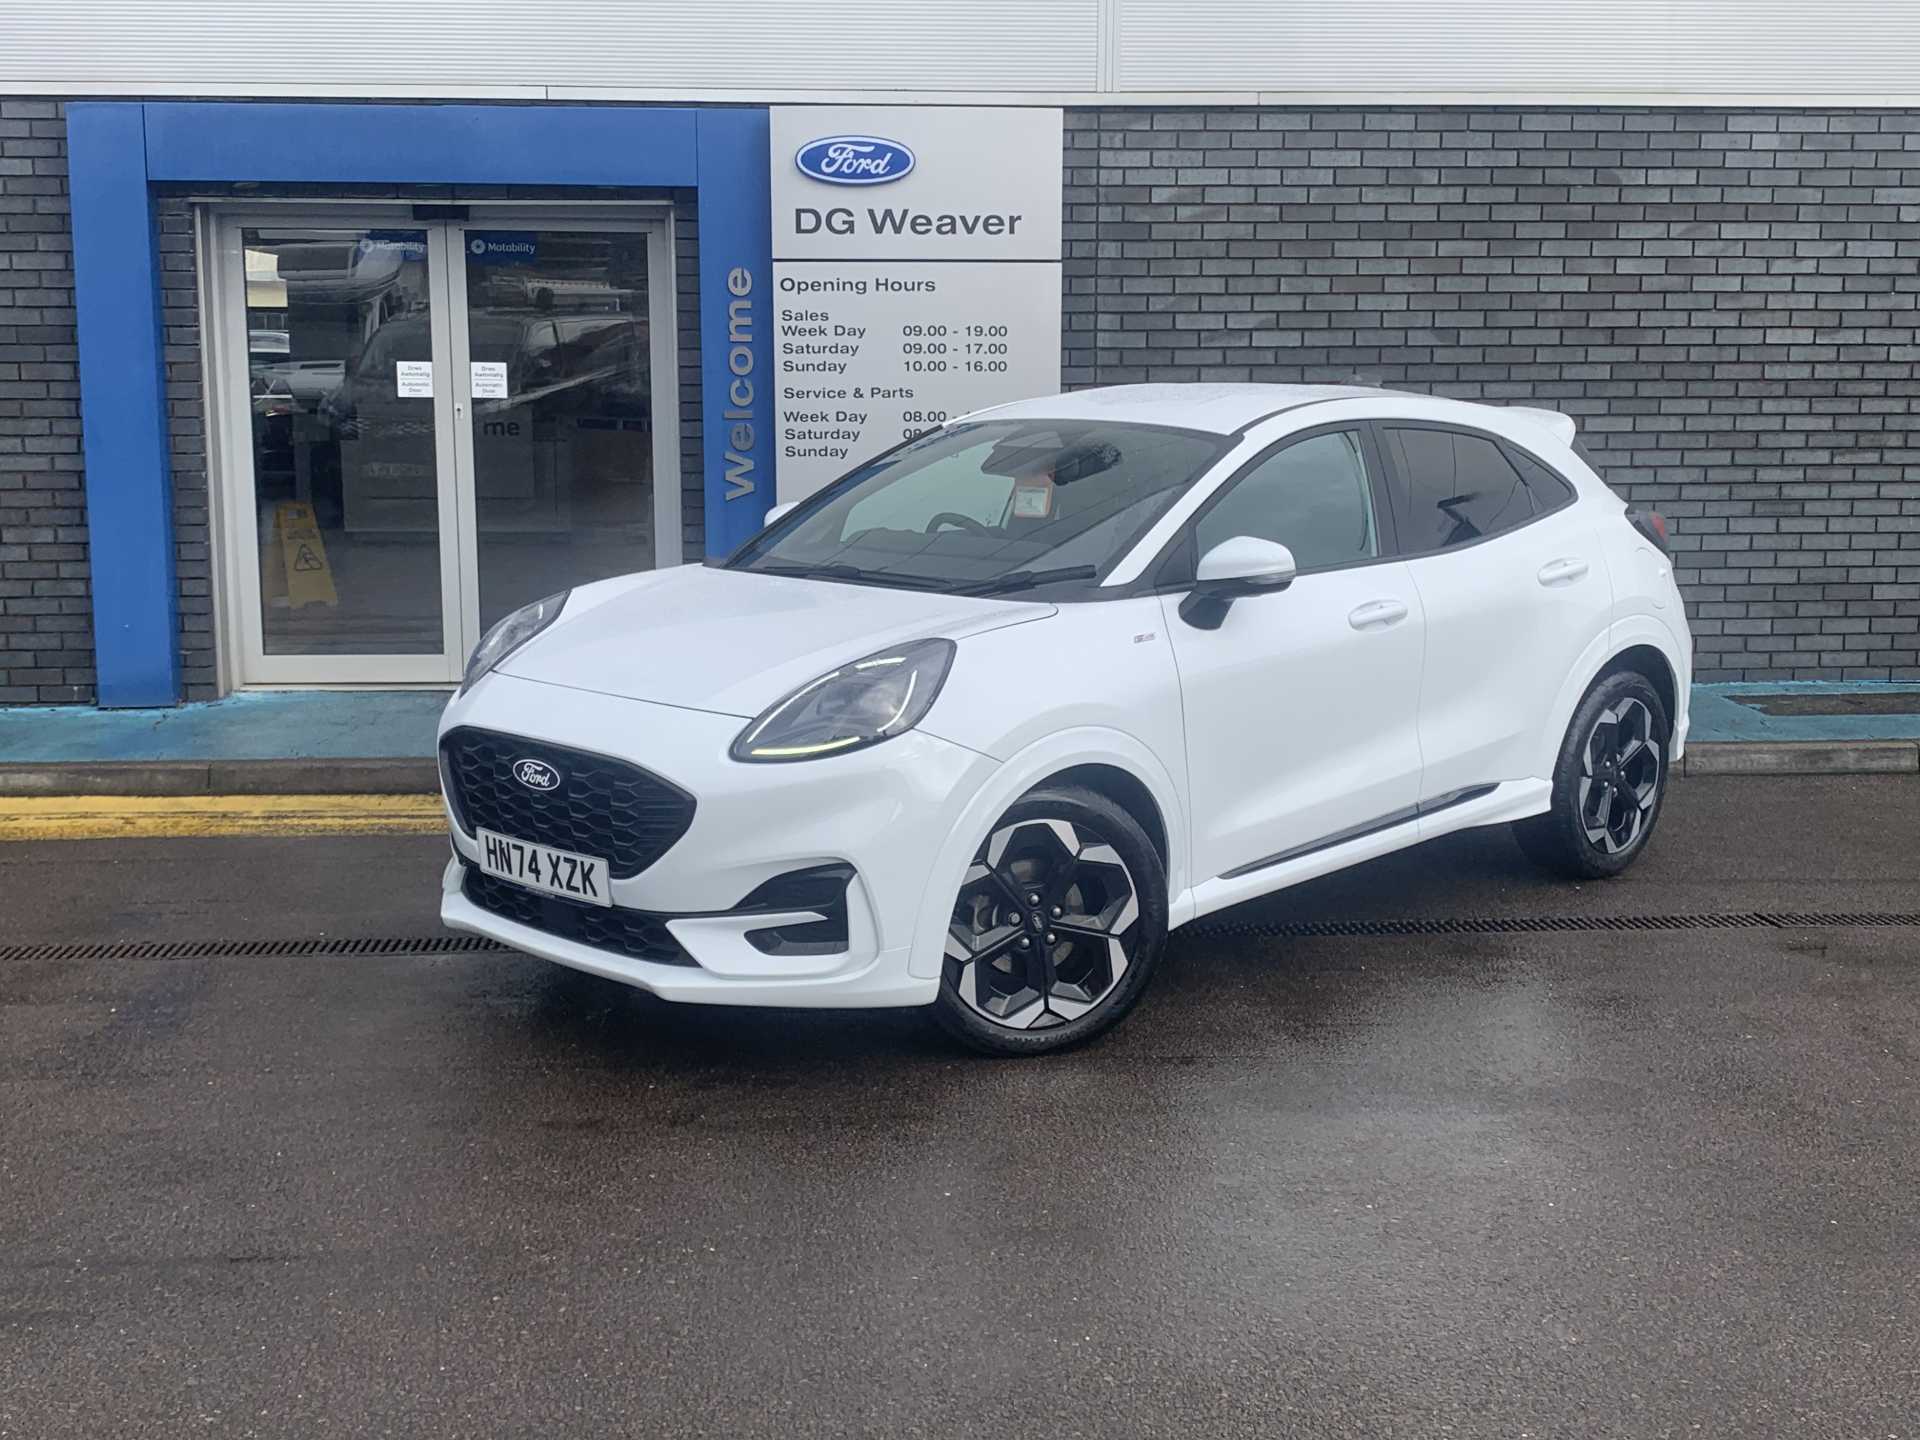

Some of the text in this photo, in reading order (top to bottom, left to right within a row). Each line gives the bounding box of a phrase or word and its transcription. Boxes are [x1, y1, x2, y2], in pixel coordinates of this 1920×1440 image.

[820, 143, 892, 175] Ford
[795, 208, 1022, 235] DG Weaver
[780, 277, 936, 294] Opening Hours
[781, 309, 829, 321] Sales
[781, 325, 827, 337] Week
[834, 325, 866, 339] Day
[902, 325, 947, 337] 09.00
[965, 326, 1008, 337] 19.00
[782, 342, 859, 356] Saturday
[902, 343, 947, 355] 09.00
[965, 343, 1008, 355] 17.00
[783, 360, 847, 374] Sunday
[904, 361, 947, 373] 10.00
[965, 361, 1008, 373] 16.00
[723, 267, 755, 501] Welcome
[783, 387, 914, 399] Service & Parts
[783, 411, 830, 423] Week
[836, 411, 868, 425] Day
[903, 411, 946, 423] 08.00
[784, 428, 860, 442] Saturday
[785, 446, 848, 460] Sunday
[520, 762, 550, 787] Ford
[484, 834, 598, 897] HN74 XZK
